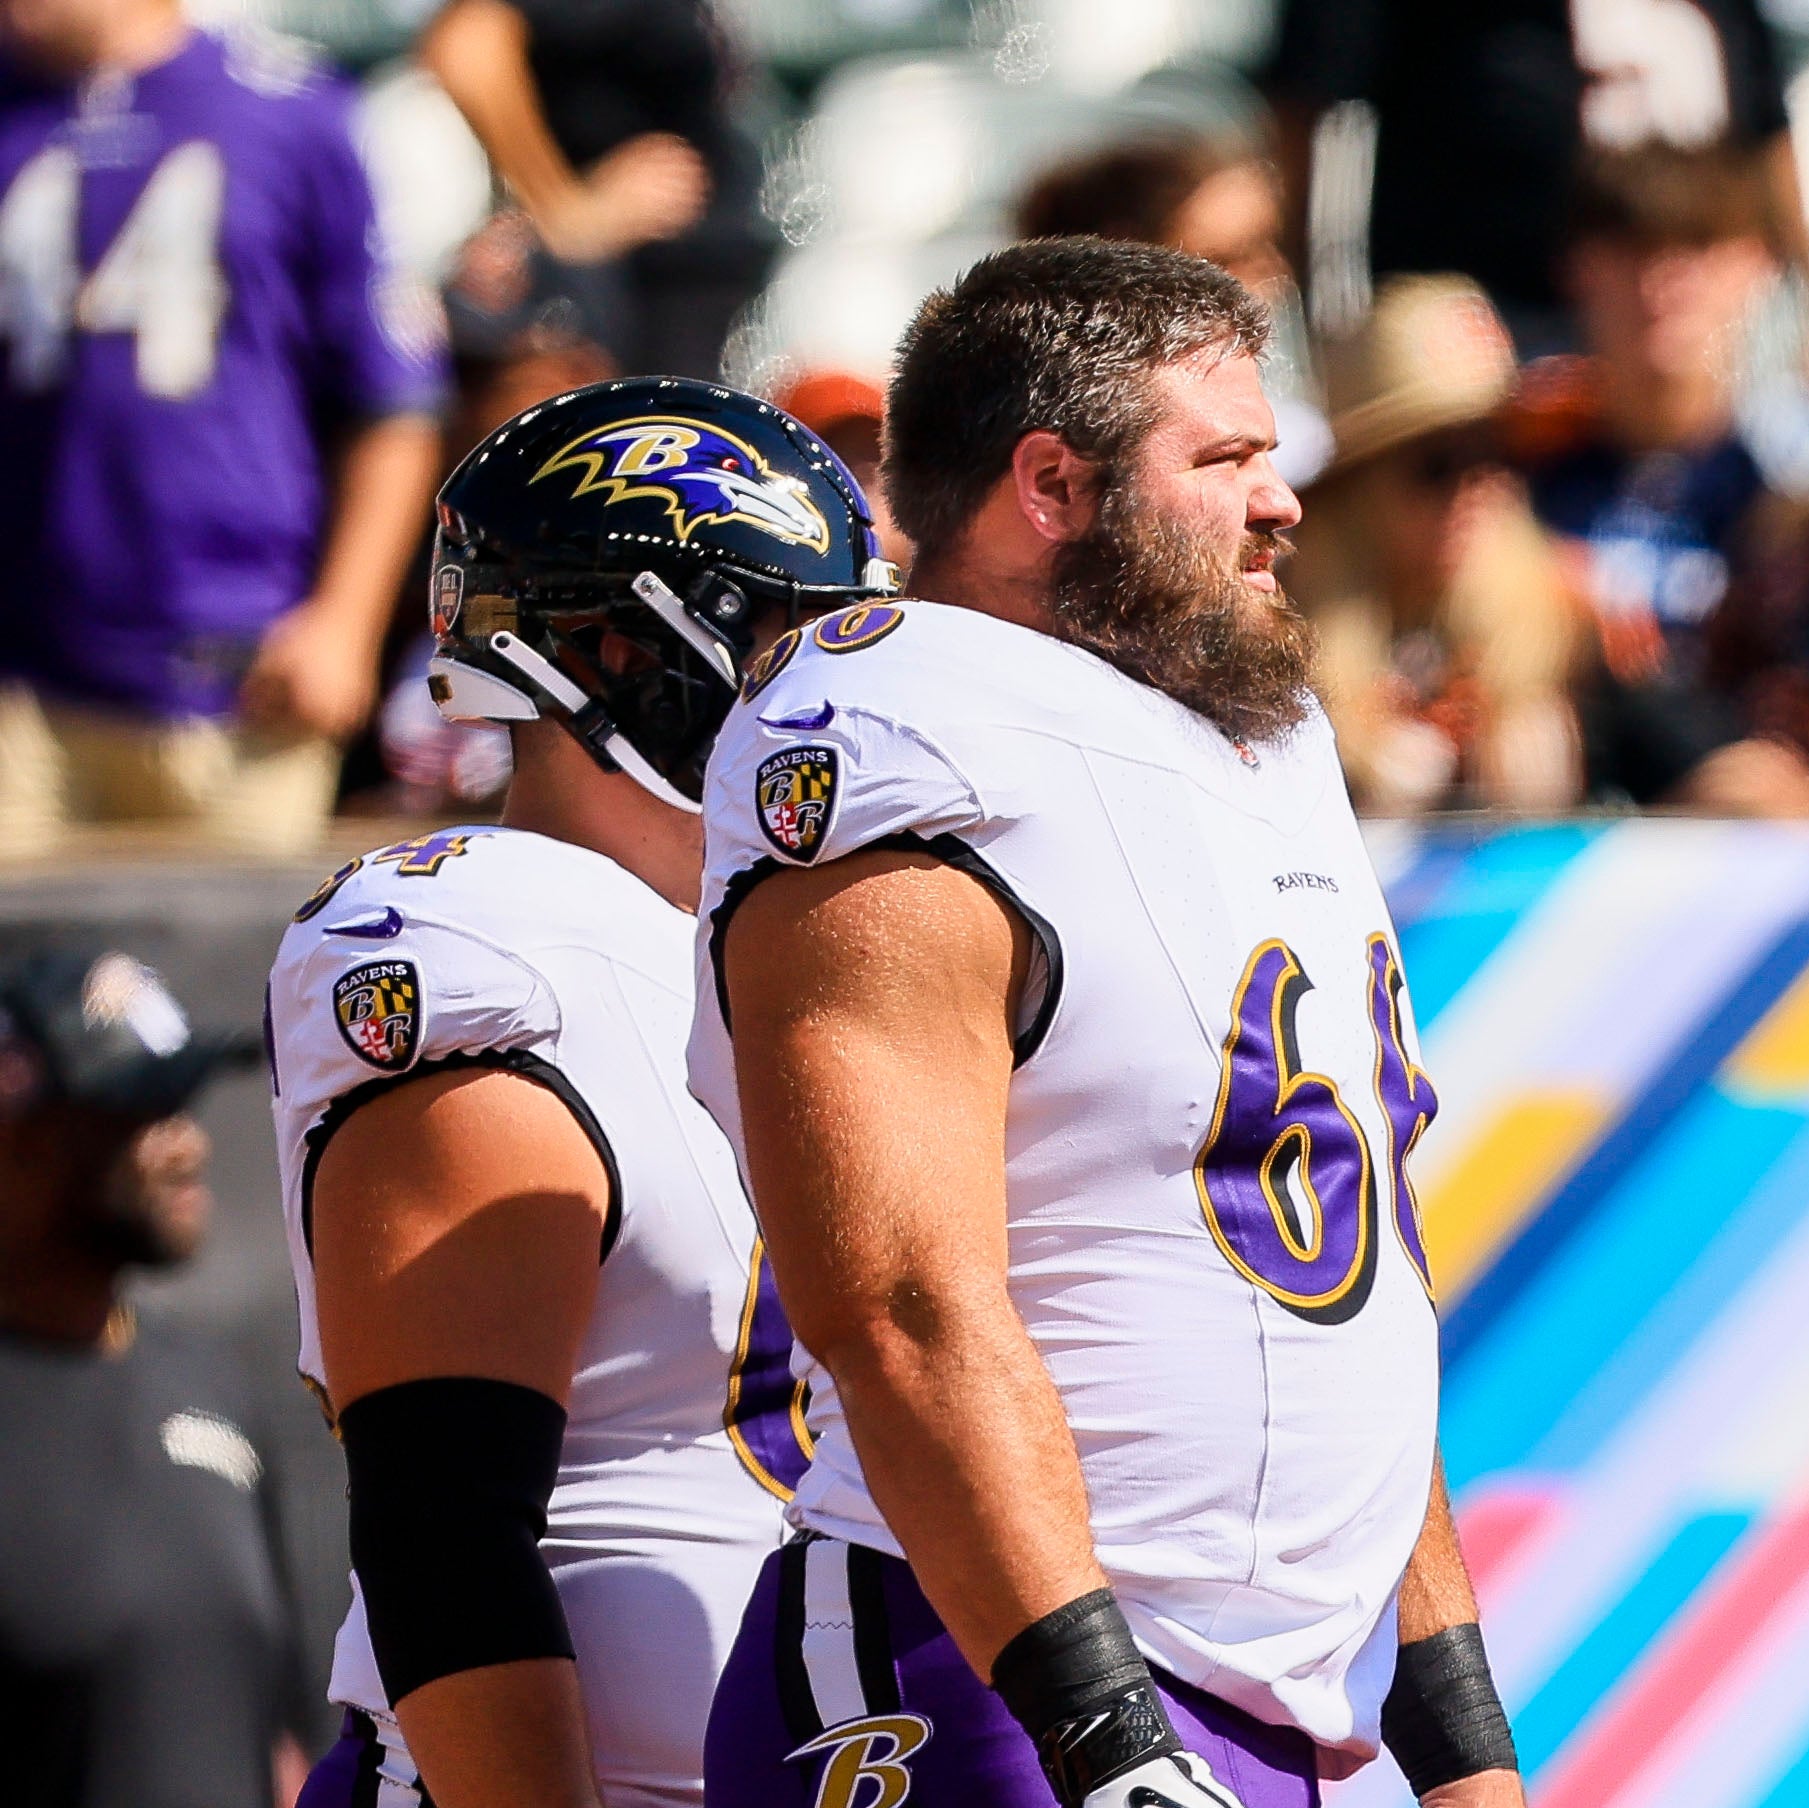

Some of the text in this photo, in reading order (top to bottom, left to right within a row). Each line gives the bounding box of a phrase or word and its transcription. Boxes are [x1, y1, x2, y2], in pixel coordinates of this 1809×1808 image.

[593, 425, 701, 477] B
[760, 750, 829, 778] RAVENS
[761, 769, 796, 807] B
[794, 800, 826, 836] R
[1272, 872, 1339, 894] RAVENS
[336, 963, 408, 994] RAVENS
[338, 985, 378, 1024] B
[381, 1013, 412, 1049] R
